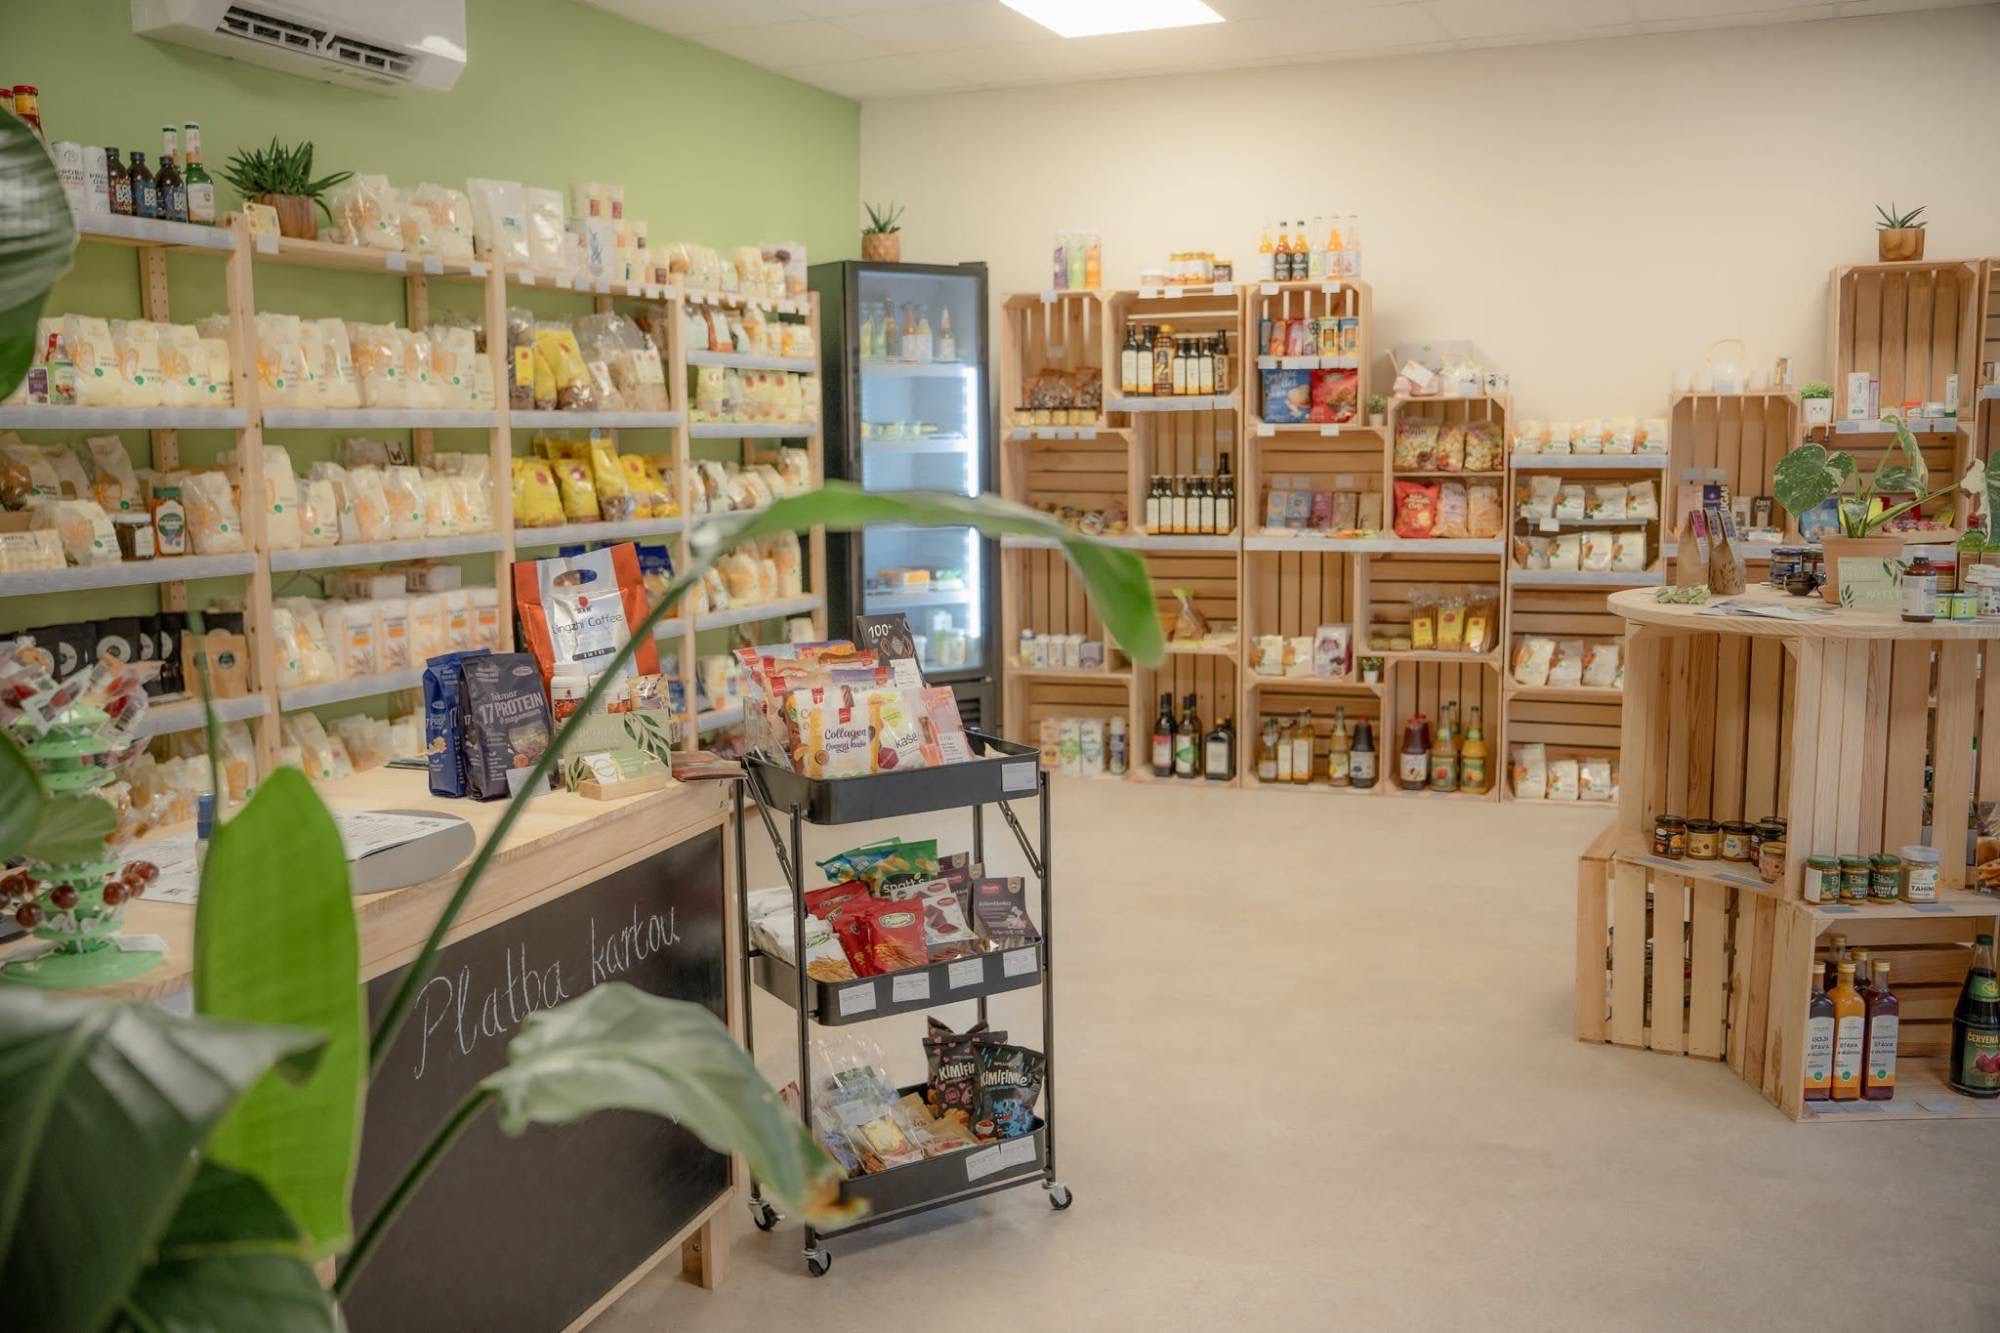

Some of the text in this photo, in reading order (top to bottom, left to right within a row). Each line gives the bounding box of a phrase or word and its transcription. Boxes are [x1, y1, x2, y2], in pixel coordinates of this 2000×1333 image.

[588, 614, 624, 627] Coffee
[494, 692, 544, 717] PROTEIN
[825, 727, 866, 741] Collagen
[414, 904, 681, 1080] Platba kartou
